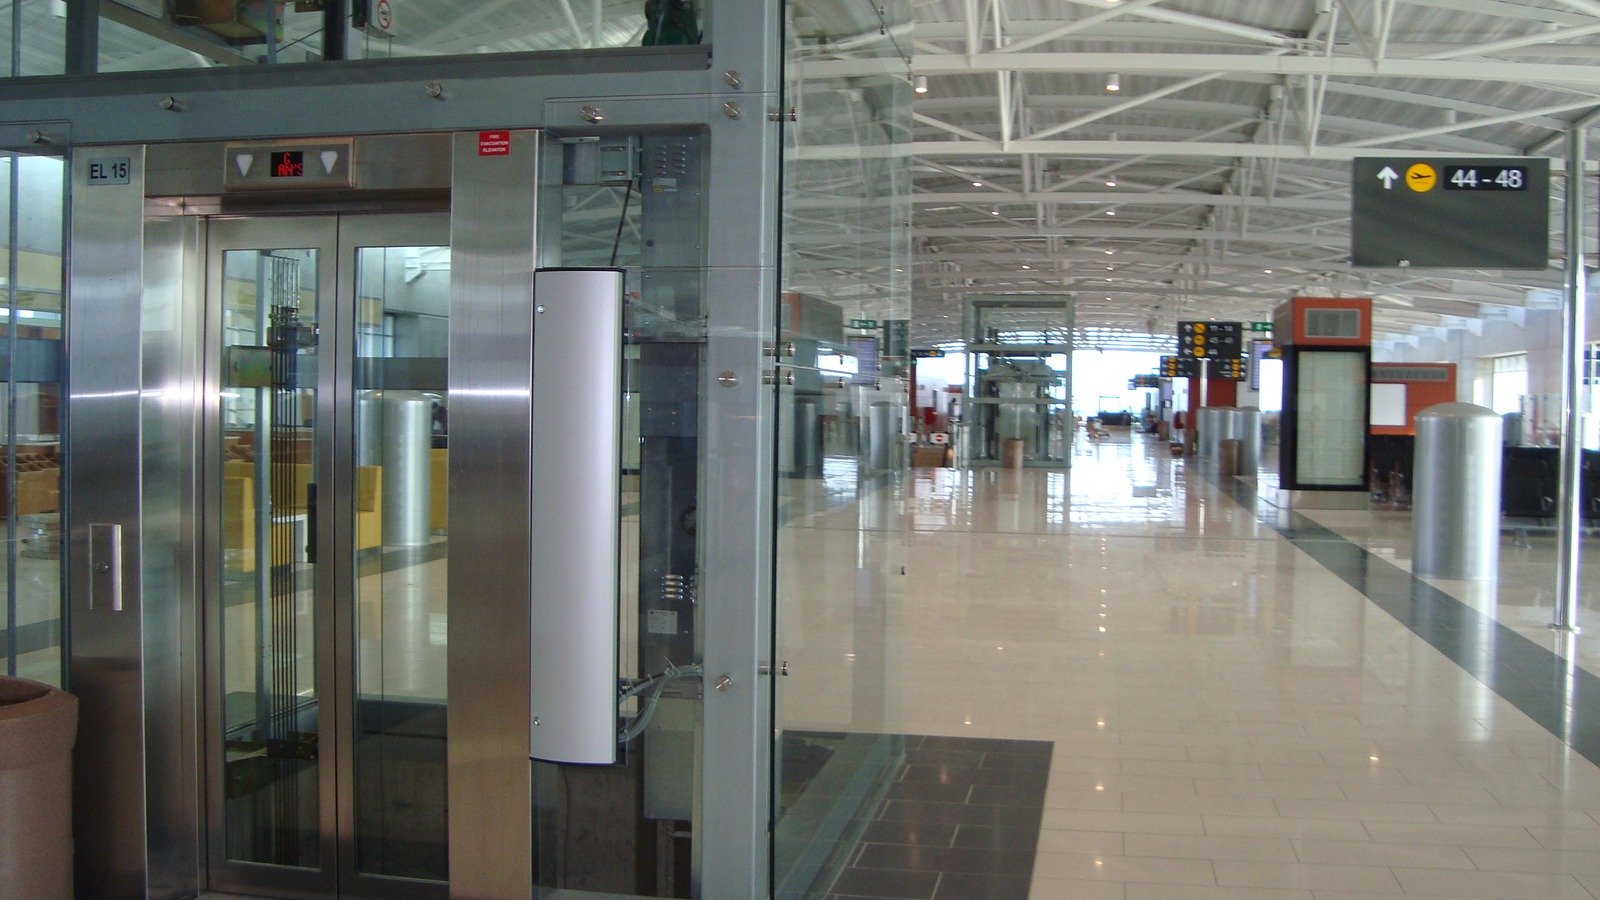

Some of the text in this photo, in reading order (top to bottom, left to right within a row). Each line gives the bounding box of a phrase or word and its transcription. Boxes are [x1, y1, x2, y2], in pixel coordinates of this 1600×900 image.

[90, 162, 127, 179] EL 15
[1450, 168, 1479, 188] 44
[1494, 168, 1523, 188] 48
